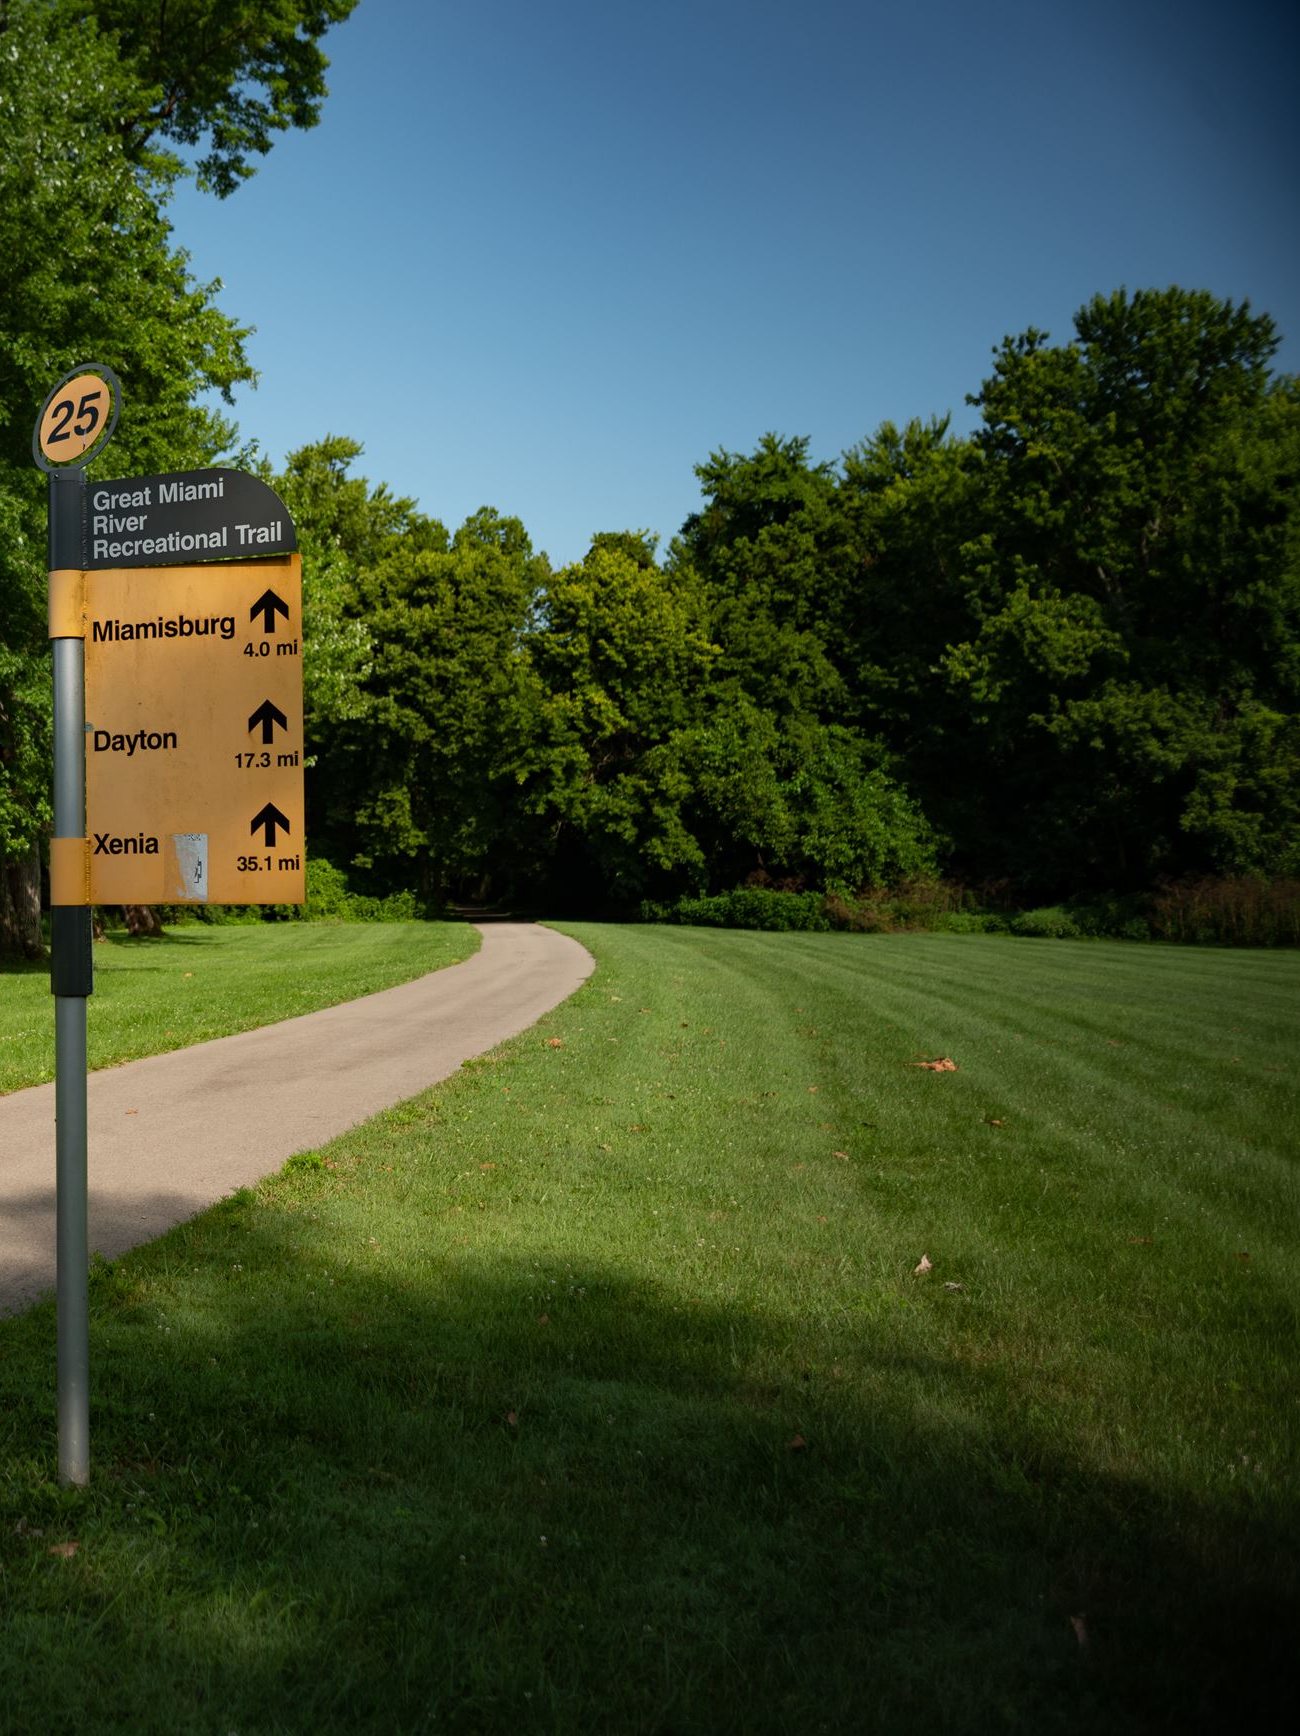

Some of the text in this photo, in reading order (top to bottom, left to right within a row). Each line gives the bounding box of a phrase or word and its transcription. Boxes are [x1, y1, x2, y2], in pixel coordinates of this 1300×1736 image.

[47, 391, 101, 445] 25
[93, 477, 224, 511] Great Miami
[93, 513, 148, 535] River
[93, 521, 282, 559] Recreational Trail
[92, 615, 235, 642] Miamisburg
[243, 640, 298, 657] 4.0 mi
[93, 730, 177, 756] Dayton
[234, 751, 299, 769] 17.3 mi
[93, 833, 159, 855] Xenia
[237, 855, 300, 872] 35.1 mi
